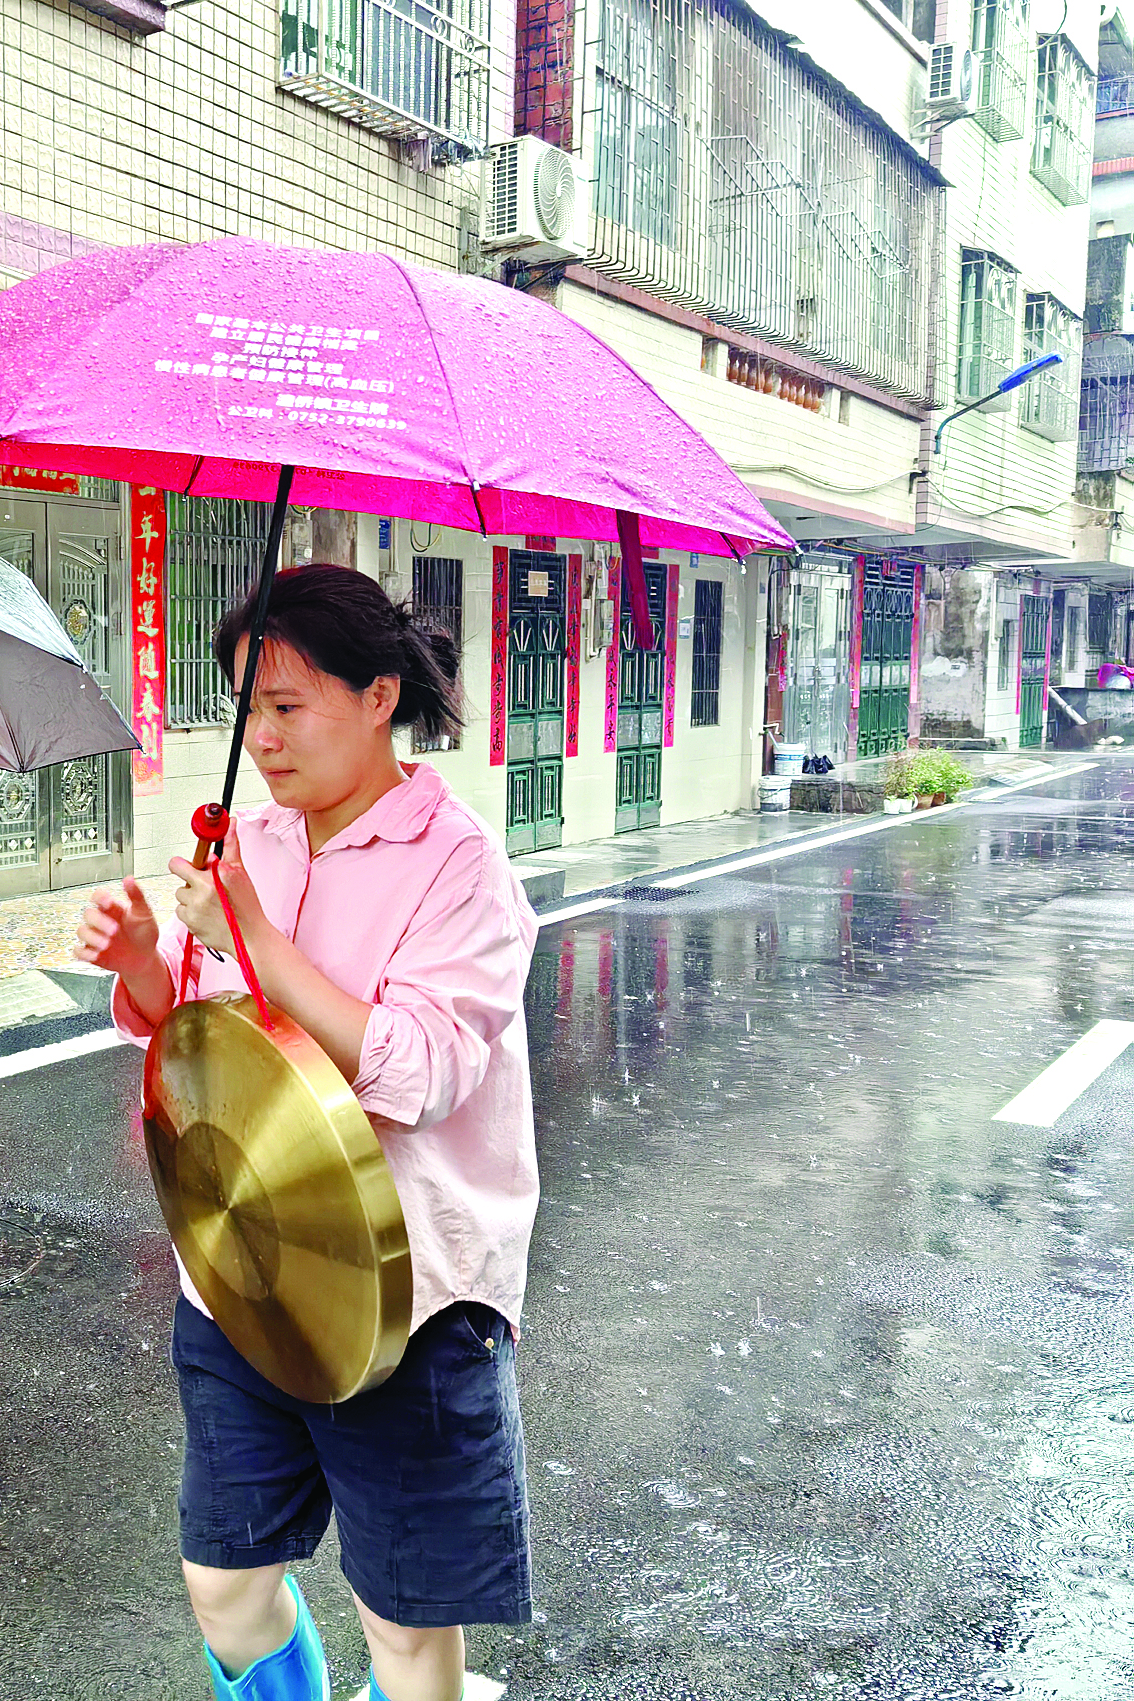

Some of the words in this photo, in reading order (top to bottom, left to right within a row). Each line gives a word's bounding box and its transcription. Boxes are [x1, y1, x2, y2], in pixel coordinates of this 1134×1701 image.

[195, 312, 380, 341] 国家基本公共卫生项目
[211, 351, 344, 375] 孕产妇健康管理
[243, 342, 318, 360] 预防接种
